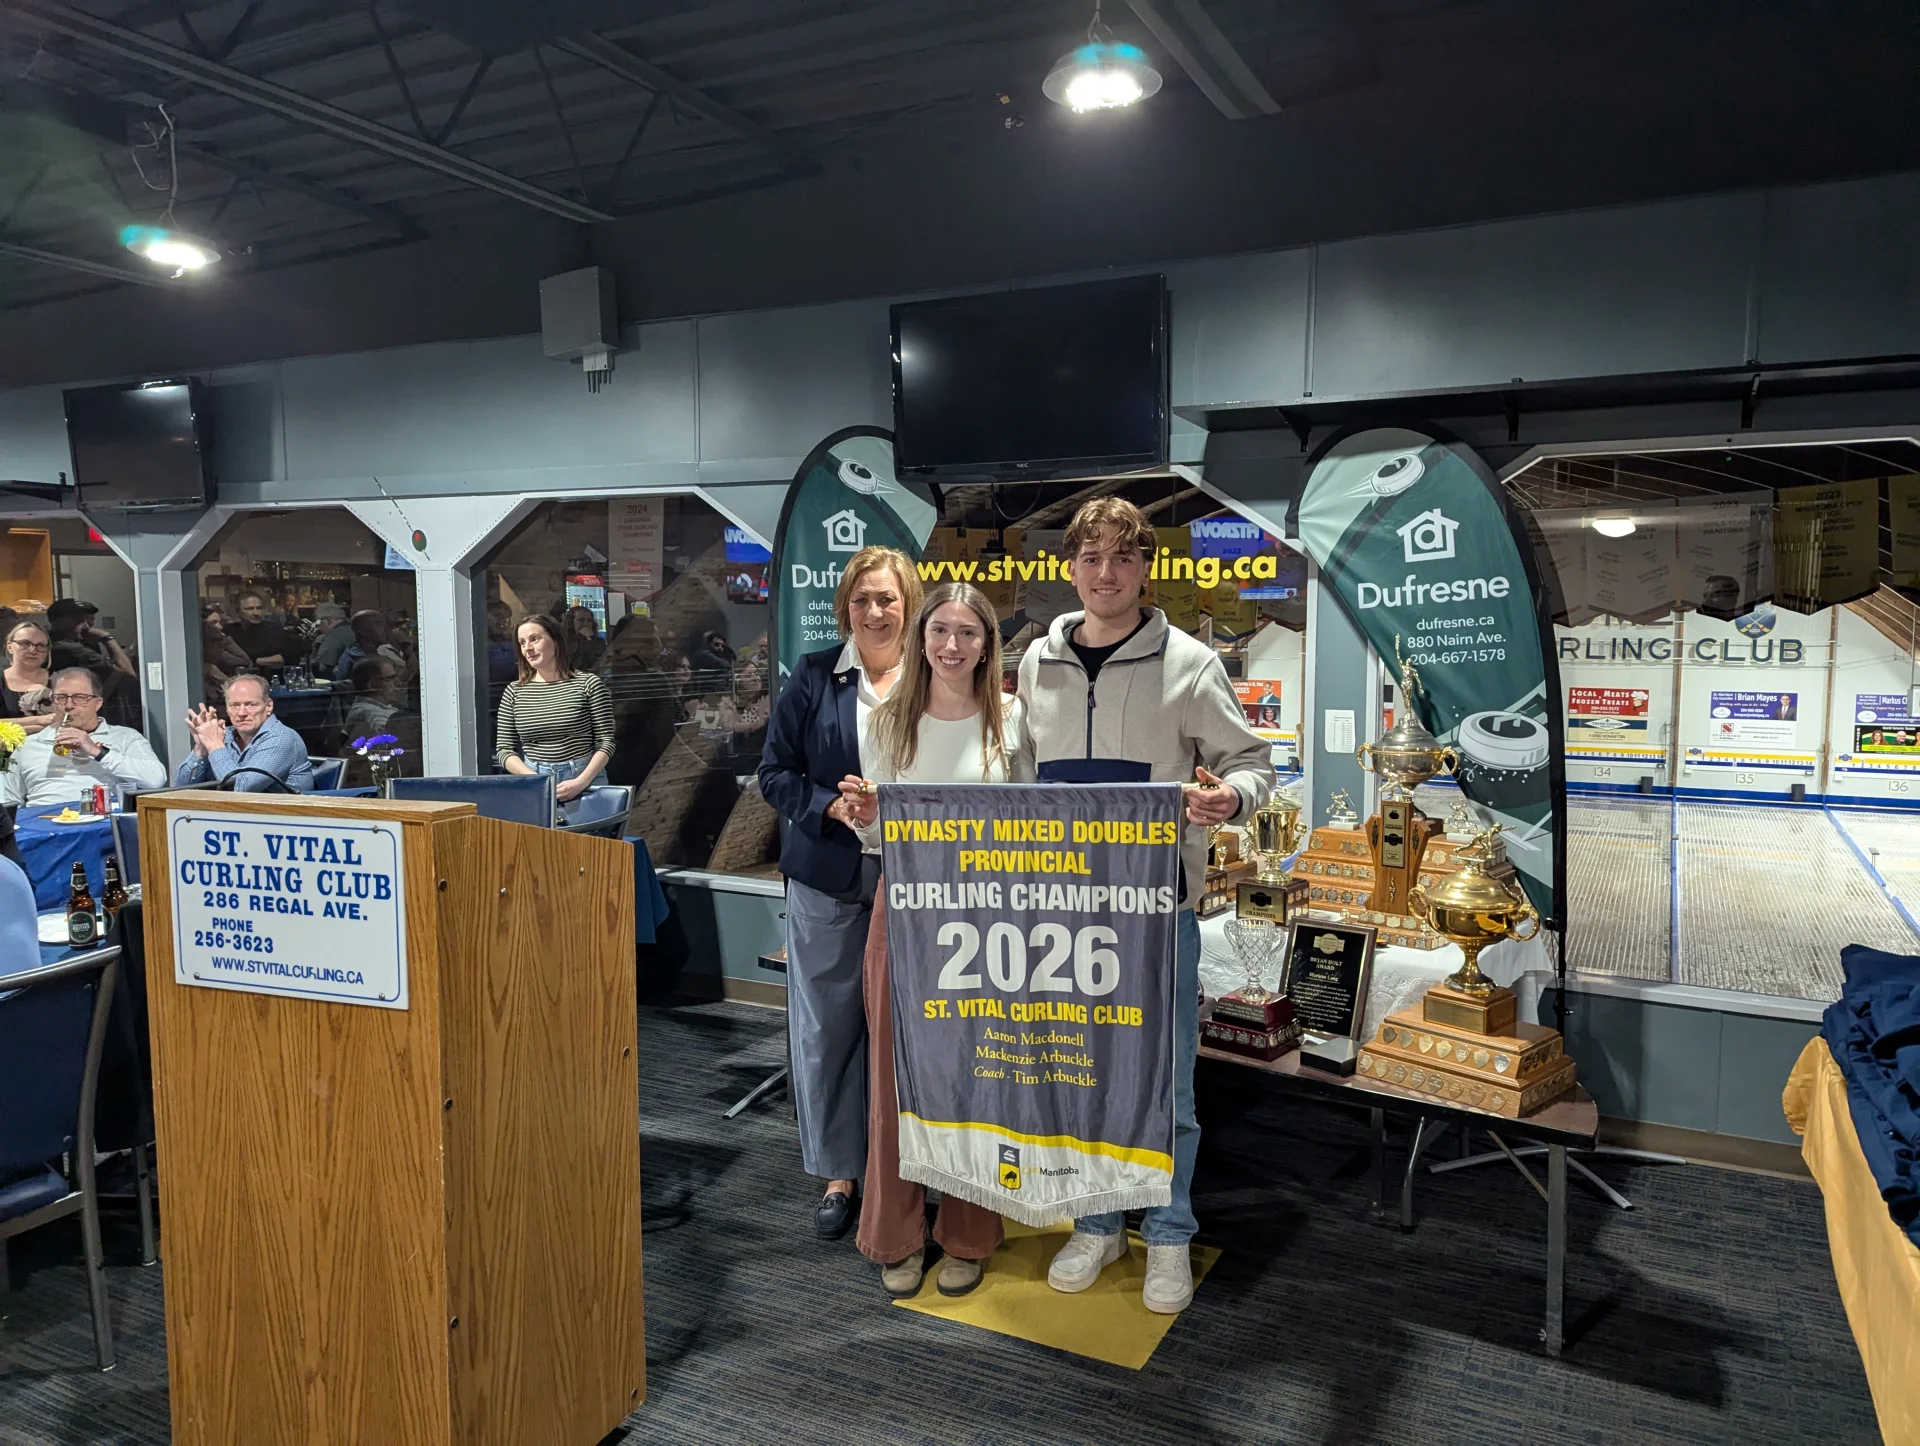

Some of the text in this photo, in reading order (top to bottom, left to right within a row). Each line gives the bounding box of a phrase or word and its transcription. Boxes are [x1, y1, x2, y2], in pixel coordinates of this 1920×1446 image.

[627, 504, 648, 514] 2024
[1358, 574, 1510, 609] Dufresne
[801, 615, 838, 626] 880 Na
[1416, 616, 1495, 631] dufresne.ca
[804, 630, 841, 641] 204-66
[1407, 632, 1507, 649] 880 Nairn Ave.
[1410, 649, 1506, 666] 204-667-1578
[1696, 638, 1803, 663] CLUB
[1738, 693, 1778, 703] Brian Mayes
[1882, 697, 1901, 705] Markus
[1594, 767, 1611, 777] 134
[1736, 774, 1754, 784] 135
[1889, 781, 1909, 792] 136
[884, 819, 1177, 845] DYNASTY MIXED DOUBLES
[204, 830, 362, 866] ST. VITAL
[960, 850, 1092, 875] PROVINCIAL
[181, 860, 392, 901] CURLING CLUB
[204, 891, 368, 921] 286 REGAL AVE.
[890, 882, 1174, 915] CURLING CHAMPIONS
[212, 918, 254, 933] PHONE
[195, 931, 274, 954] 256-3623
[937, 922, 1121, 997] 2026
[924, 999, 1143, 1026] ST. VITAL CURLING CLUB
[984, 1027, 1085, 1047] Aaron Macdonell
[976, 1046, 1094, 1068] Mackenzie Arbuckle
[974, 1066, 1005, 1080] Coach
[1013, 1070, 1039, 1085] Tim
[1043, 1072, 1097, 1087] Arbuckle
[1040, 1166, 1080, 1178] Manitoba
